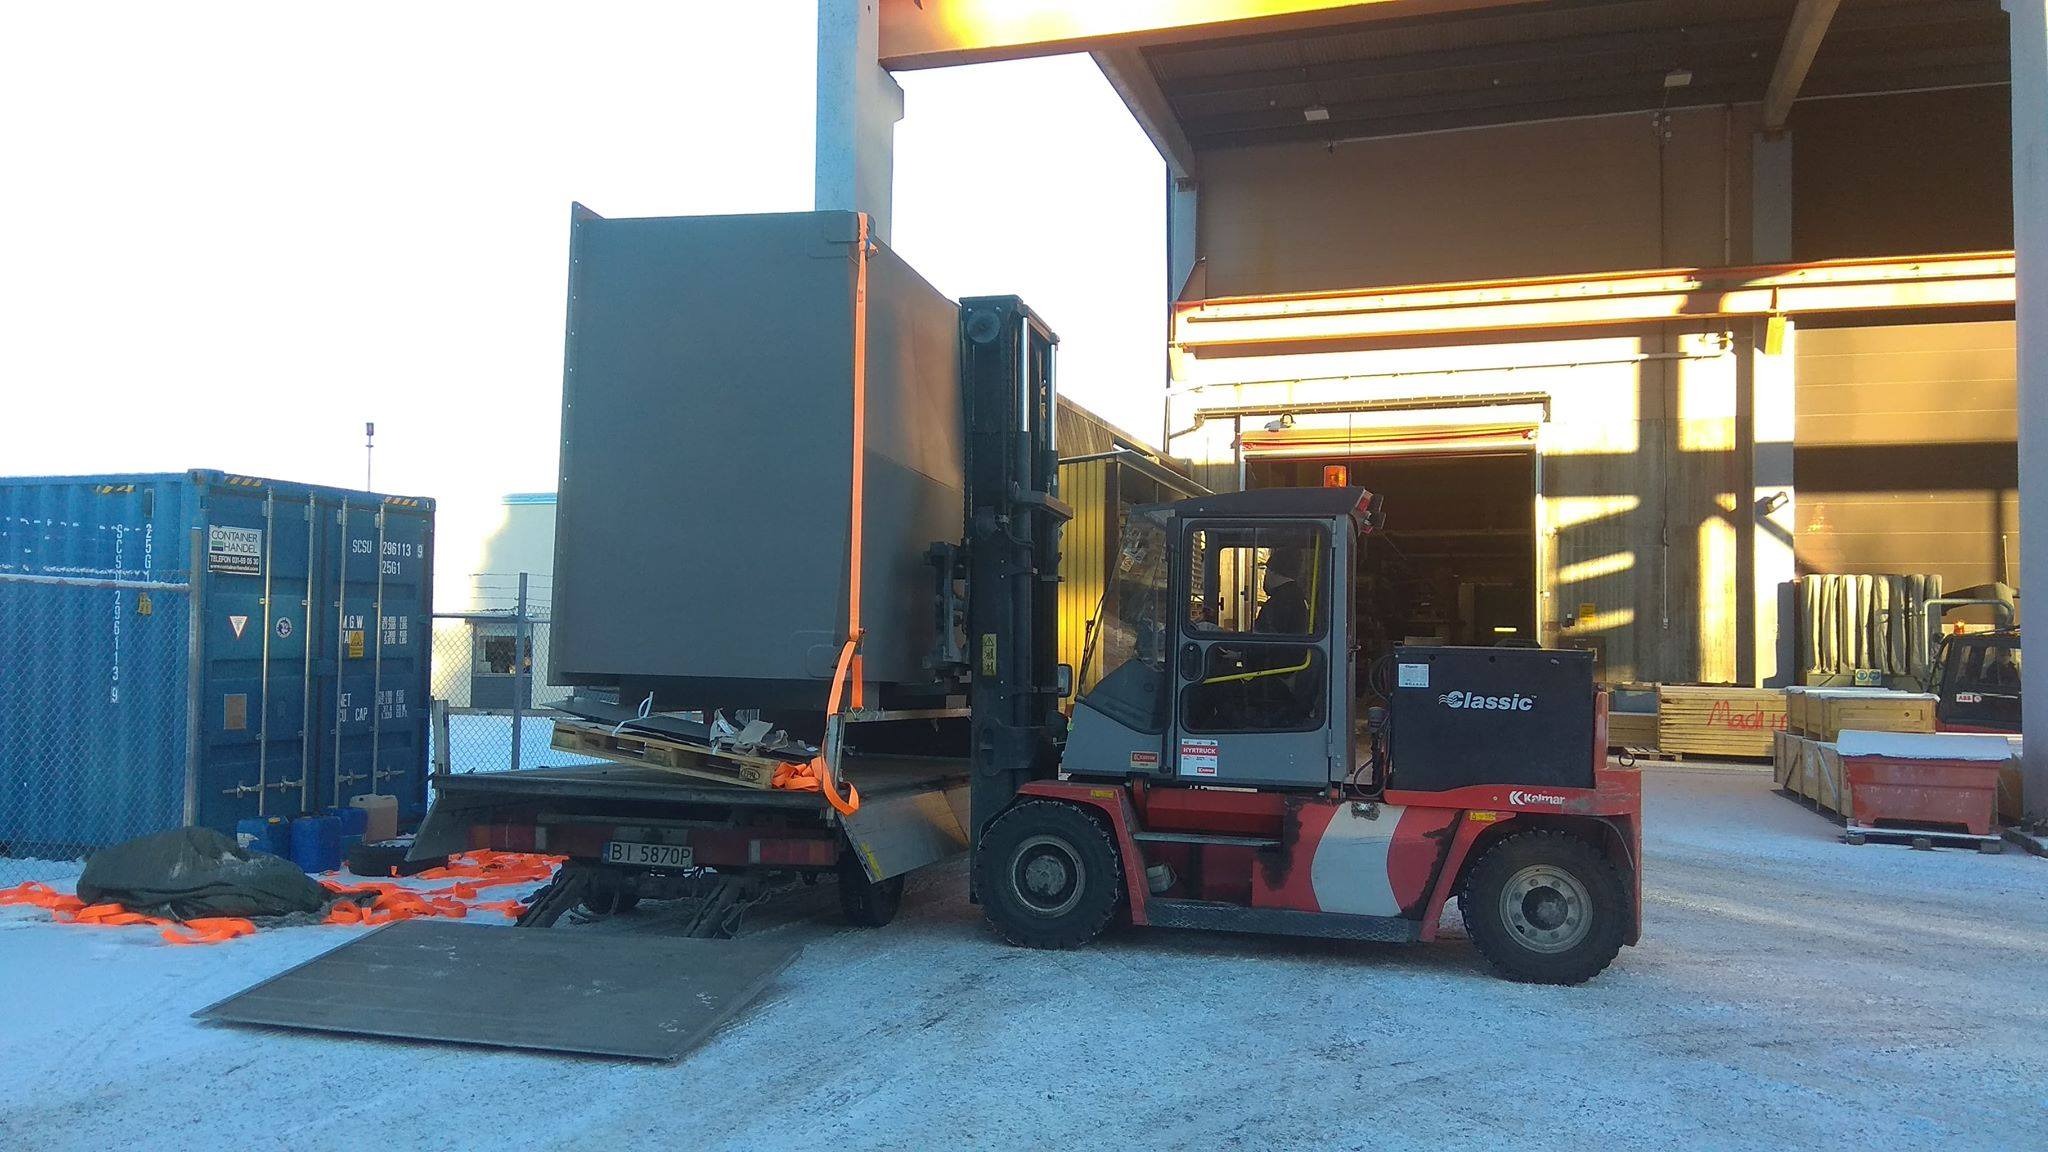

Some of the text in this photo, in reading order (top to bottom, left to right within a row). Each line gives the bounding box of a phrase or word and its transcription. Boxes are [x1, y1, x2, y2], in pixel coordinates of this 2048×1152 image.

[211, 530, 258, 543] CONTAINER
[224, 541, 258, 553] HANDEL
[352, 539, 372, 554] SCSU
[382, 542, 411, 557] 296113
[210, 555, 231, 563] TELEFON
[382, 561, 400, 574] 25G1
[1447, 690, 1532, 711] Classic
[612, 844, 630, 861] BI
[641, 846, 691, 865] 5870P
